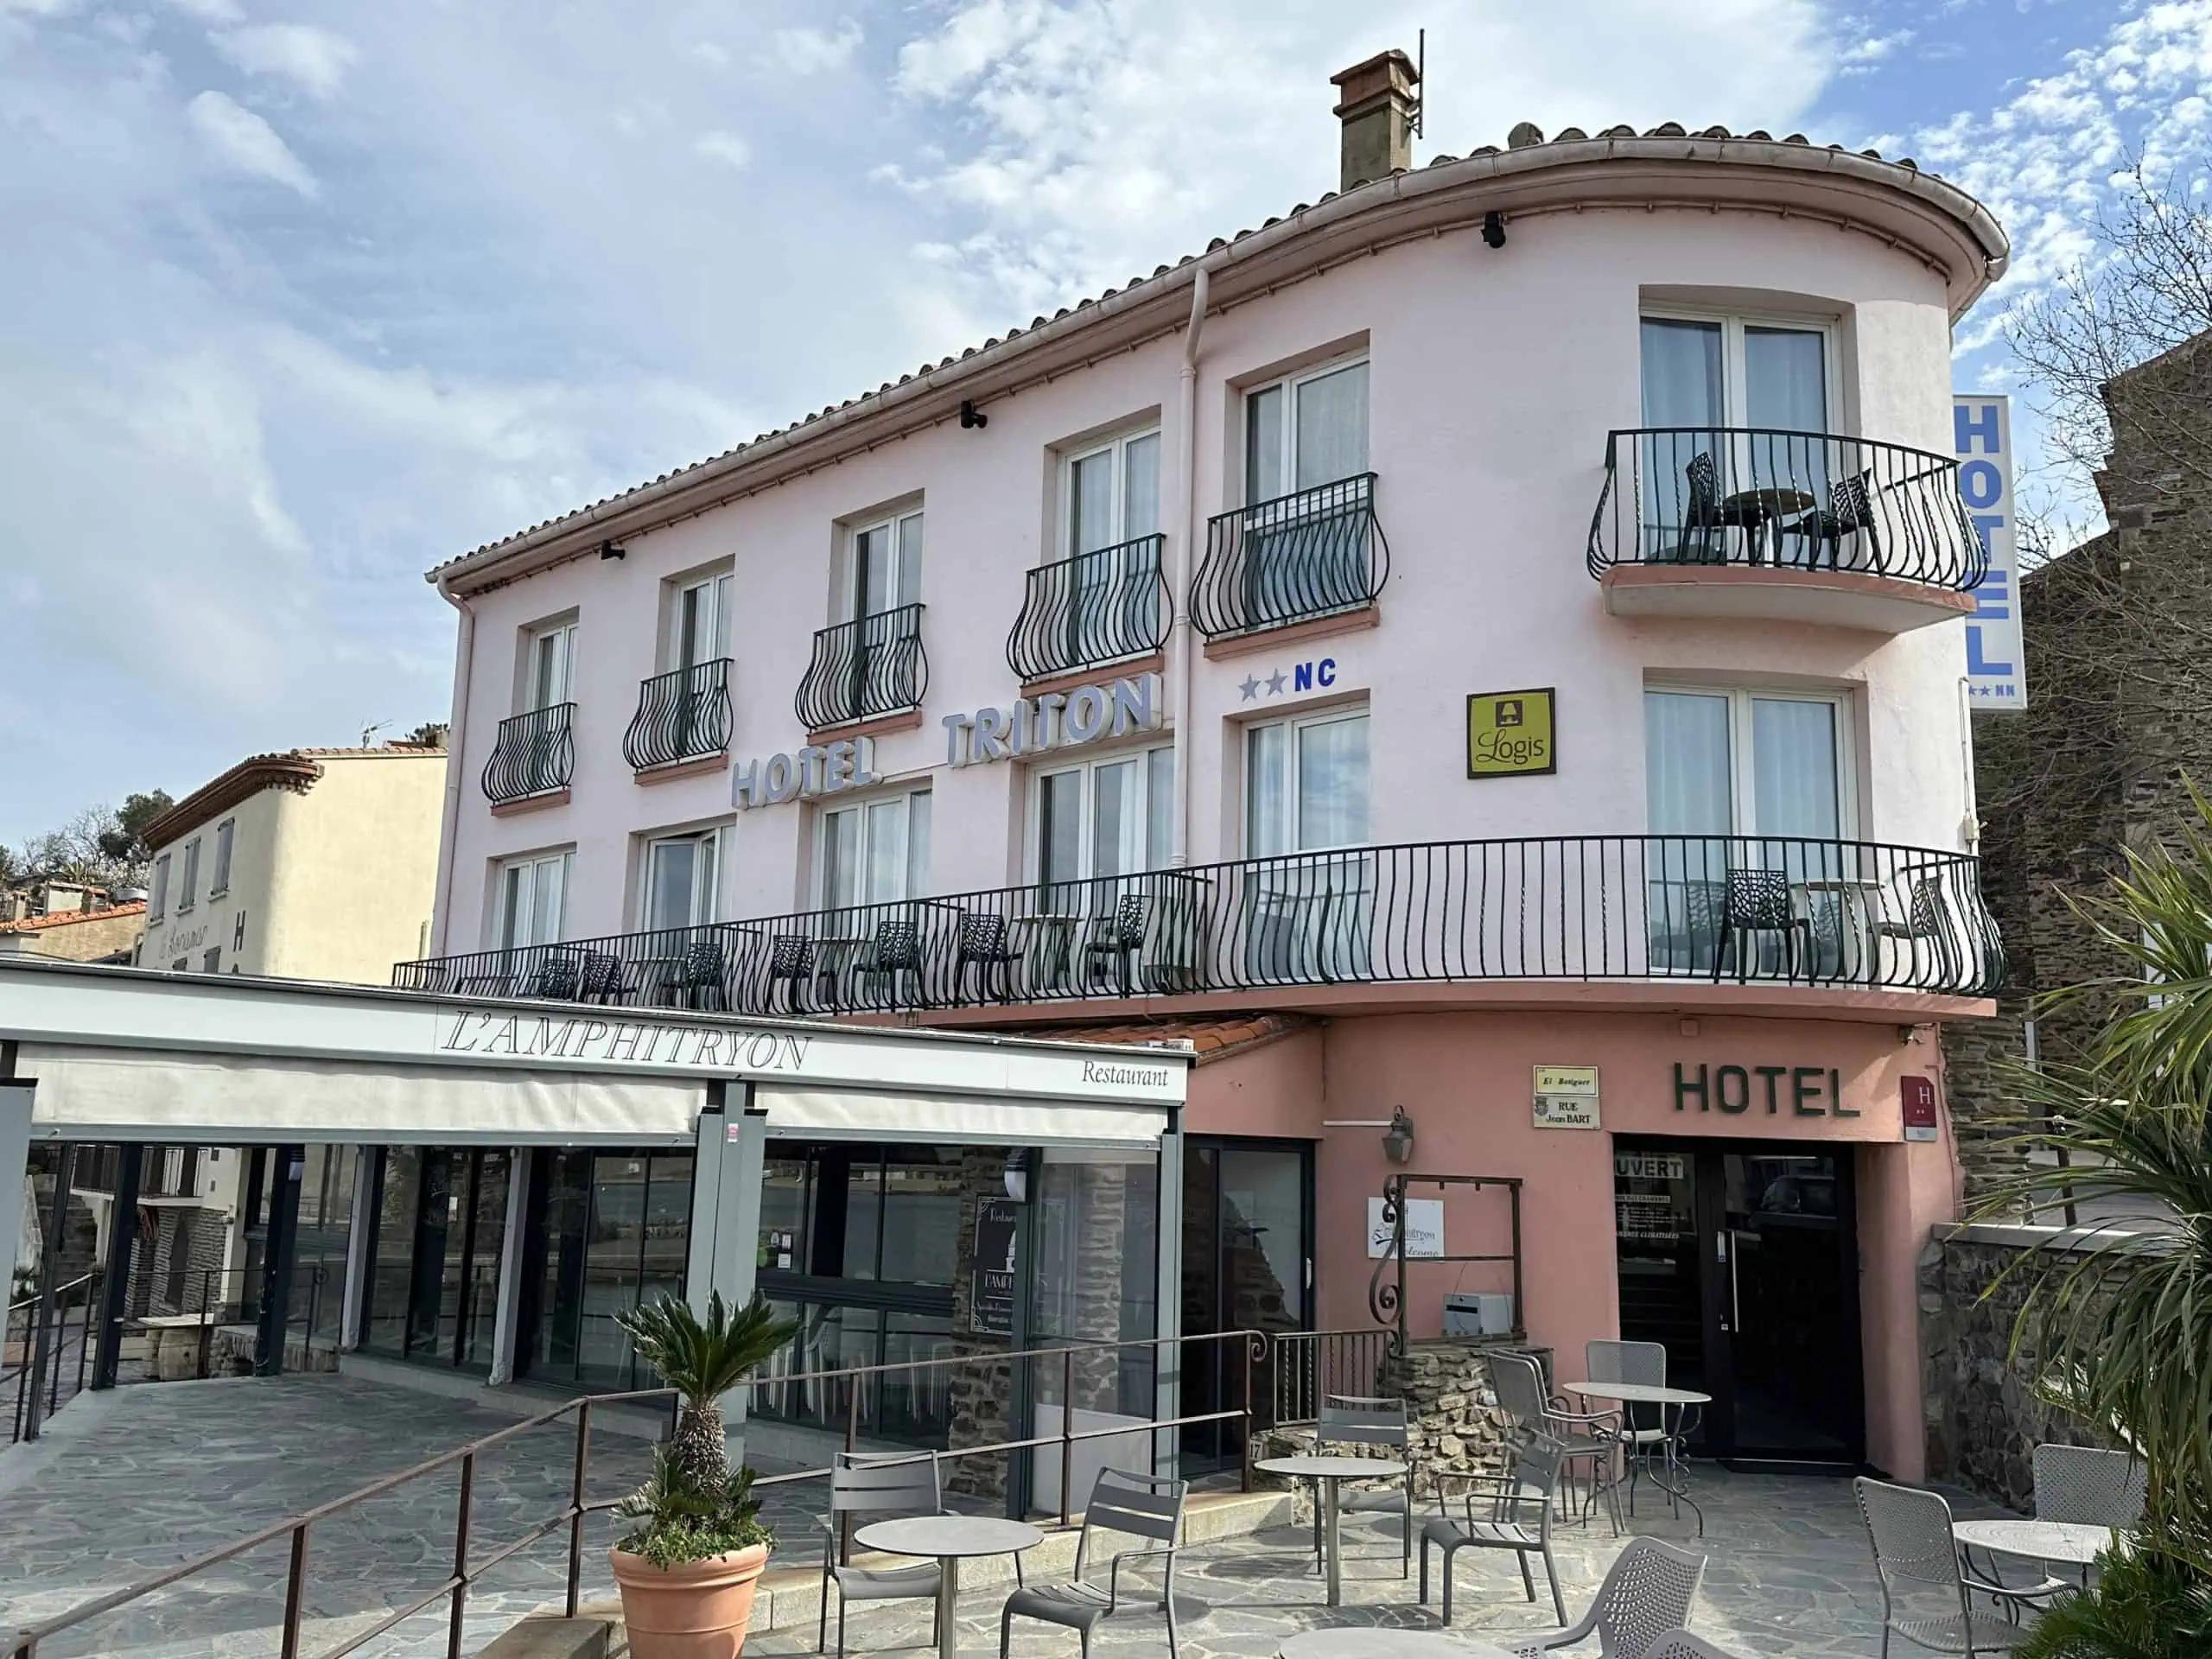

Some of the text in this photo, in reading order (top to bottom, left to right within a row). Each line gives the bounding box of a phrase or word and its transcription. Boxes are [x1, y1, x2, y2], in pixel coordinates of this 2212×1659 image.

[1954, 405, 2013, 676] HOTEL
[1294, 658, 1336, 691] NC
[731, 672, 1162, 809] HOTEL TRITON
[1476, 728, 1544, 765] Logis
[1083, 1060, 1168, 1086] Restaurant
[1674, 1062, 1860, 1118] HOTEL
[1918, 1086, 1930, 1104] H
[1558, 1102, 1580, 1112] RUE
[1567, 1114, 1592, 1124] BART
[1616, 1160, 1681, 1176] UVERT
